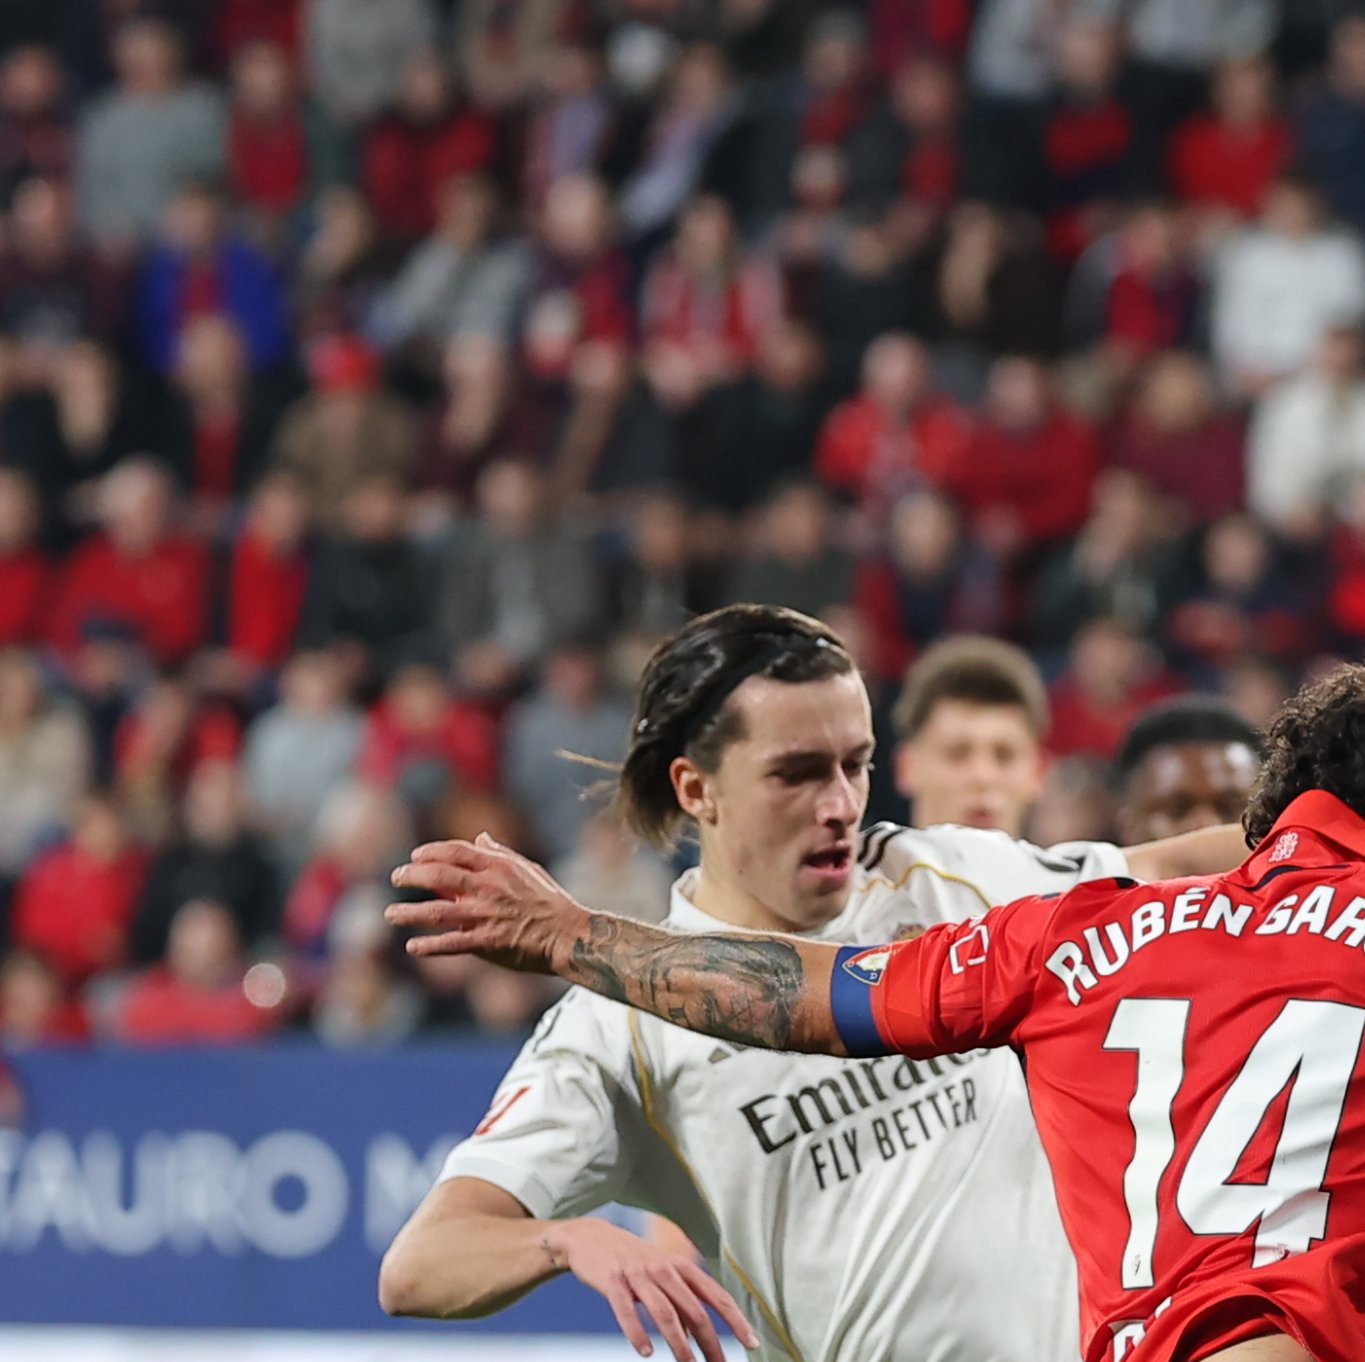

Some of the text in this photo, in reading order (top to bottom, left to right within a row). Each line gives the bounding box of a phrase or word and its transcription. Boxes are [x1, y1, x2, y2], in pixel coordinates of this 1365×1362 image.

[1045, 885, 1254, 1005] RUBÉN
[809, 1077, 979, 1191] FLY BETTER
